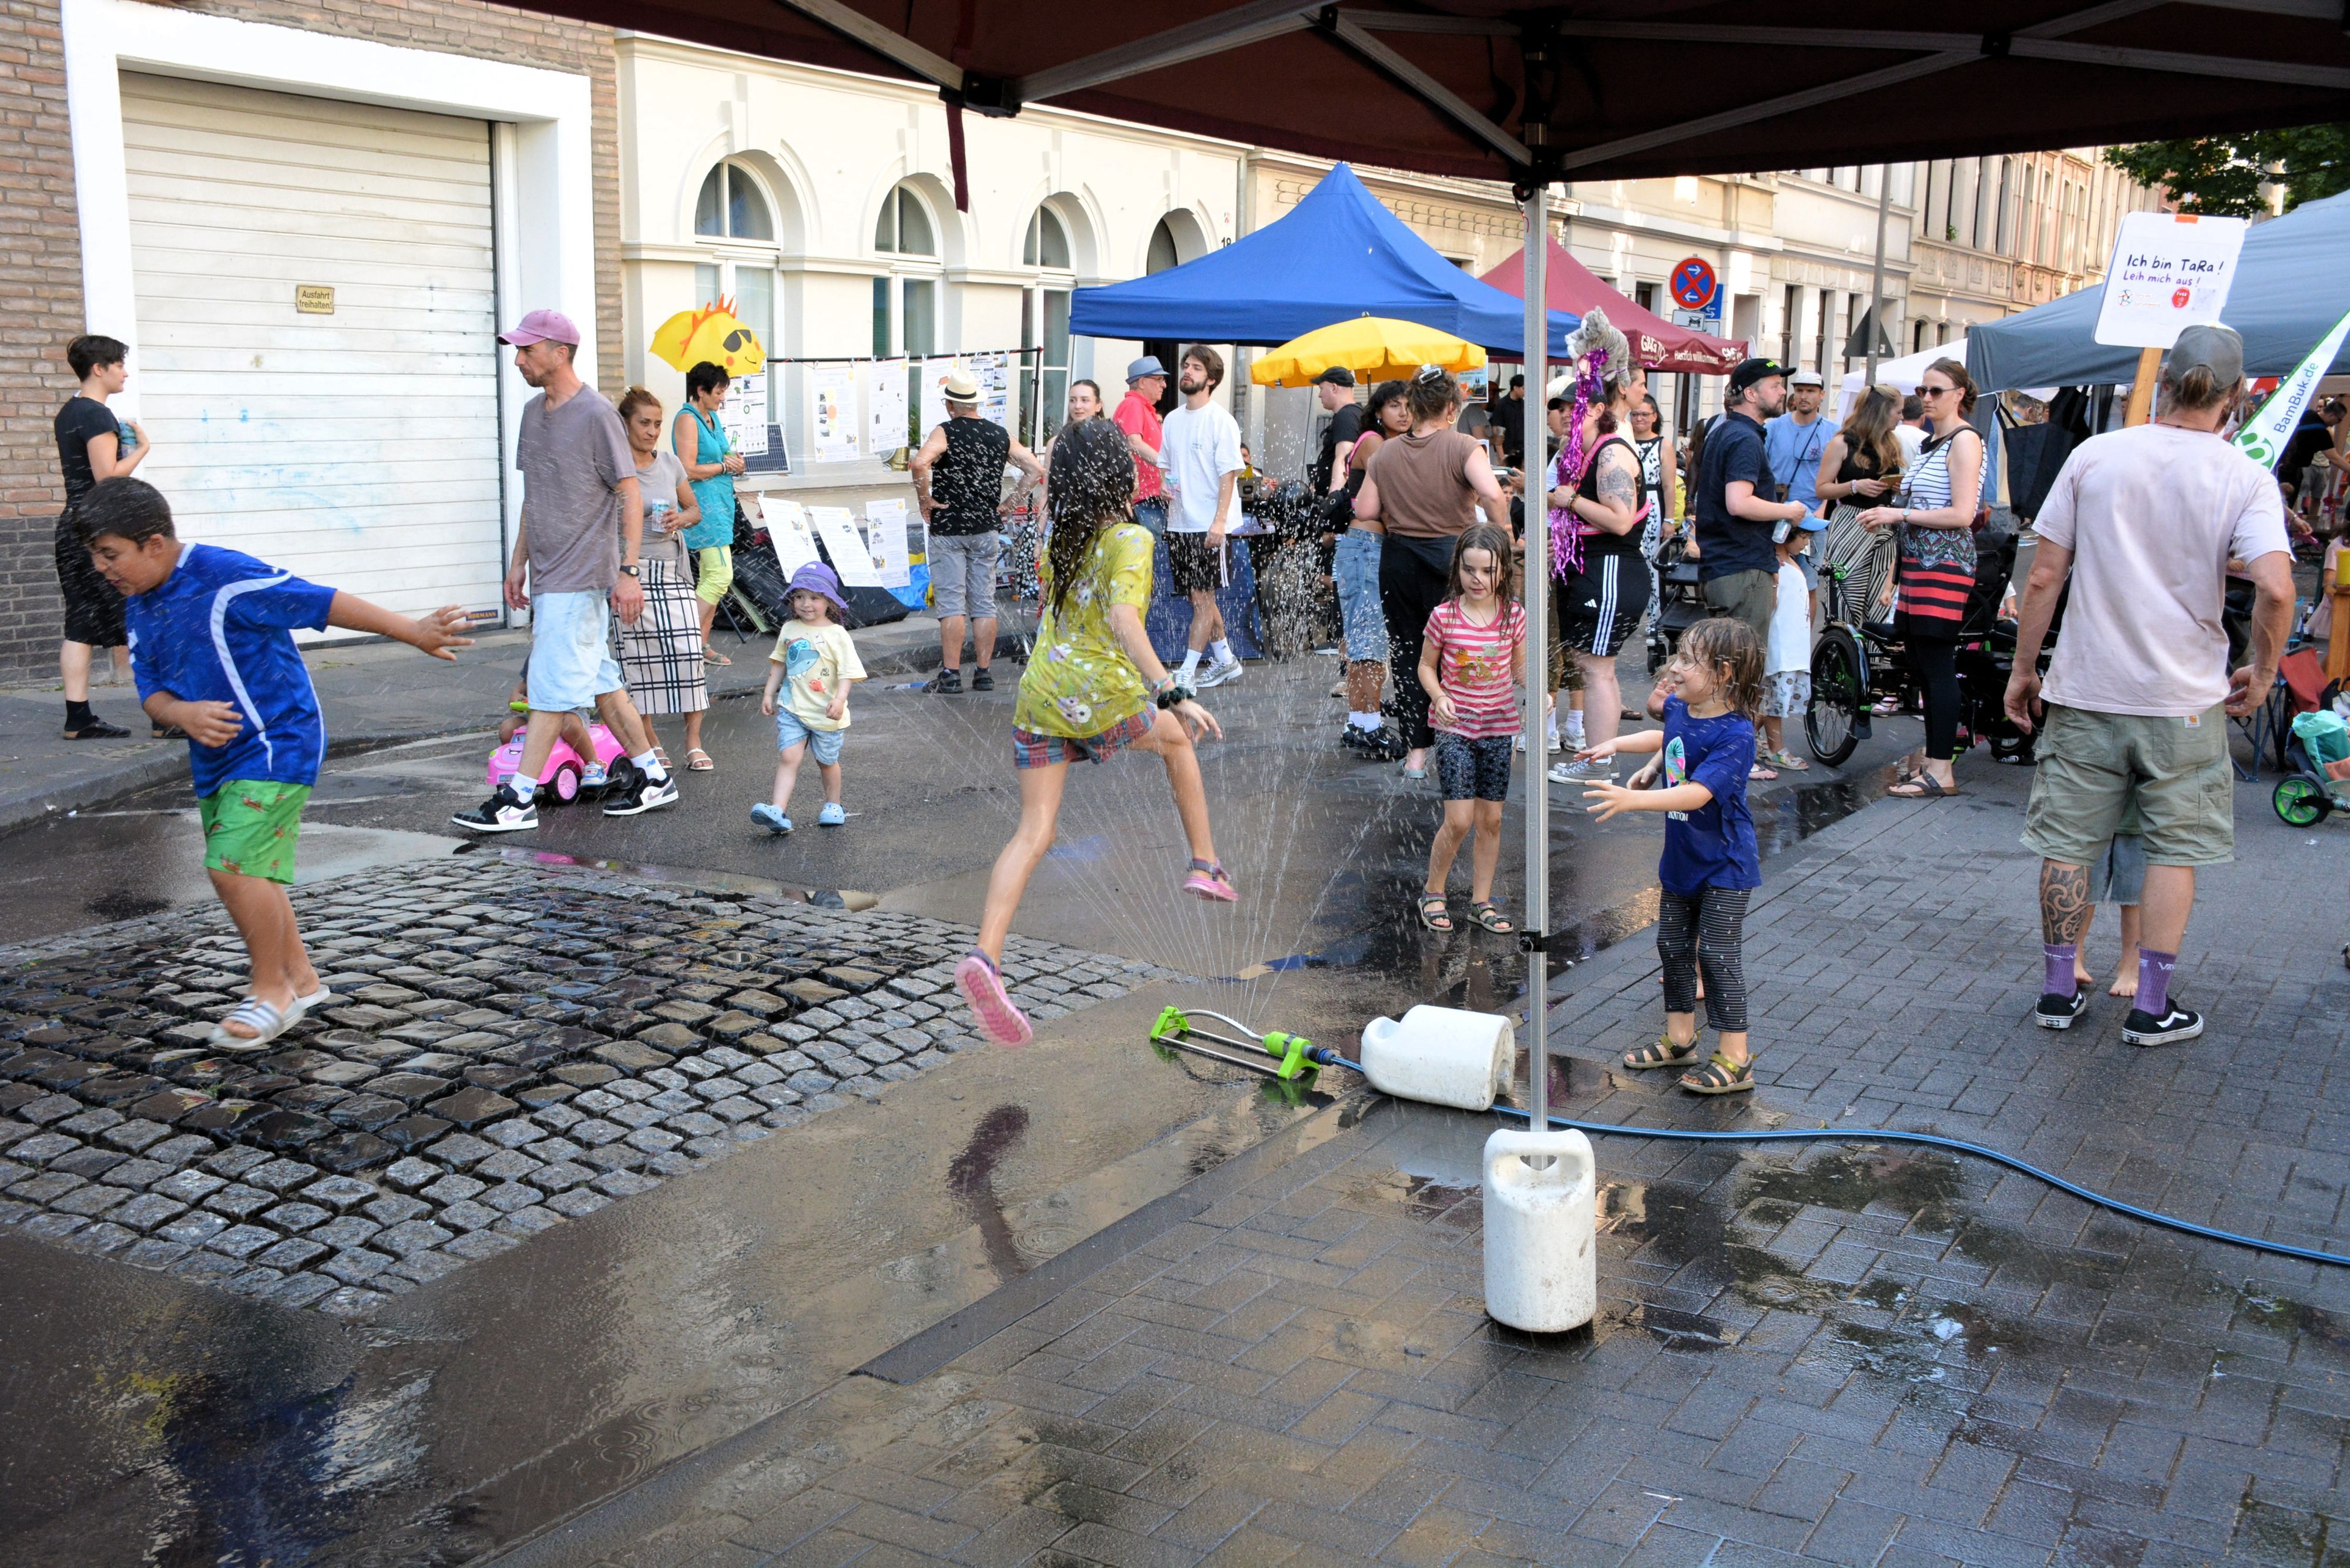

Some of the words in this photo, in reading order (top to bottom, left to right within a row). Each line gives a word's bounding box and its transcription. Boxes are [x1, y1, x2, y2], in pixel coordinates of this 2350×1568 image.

[2127, 254, 2147, 267] Ich
[2152, 255, 2171, 269] bin
[2123, 270, 2144, 281] Leih
[2147, 273, 2171, 284] mich
[301, 290, 330, 300] Ausfahrt
[299, 300, 333, 310] freihalten!
[1640, 335, 1658, 352] GAG
[2274, 362, 2318, 434] BamBuk.de
